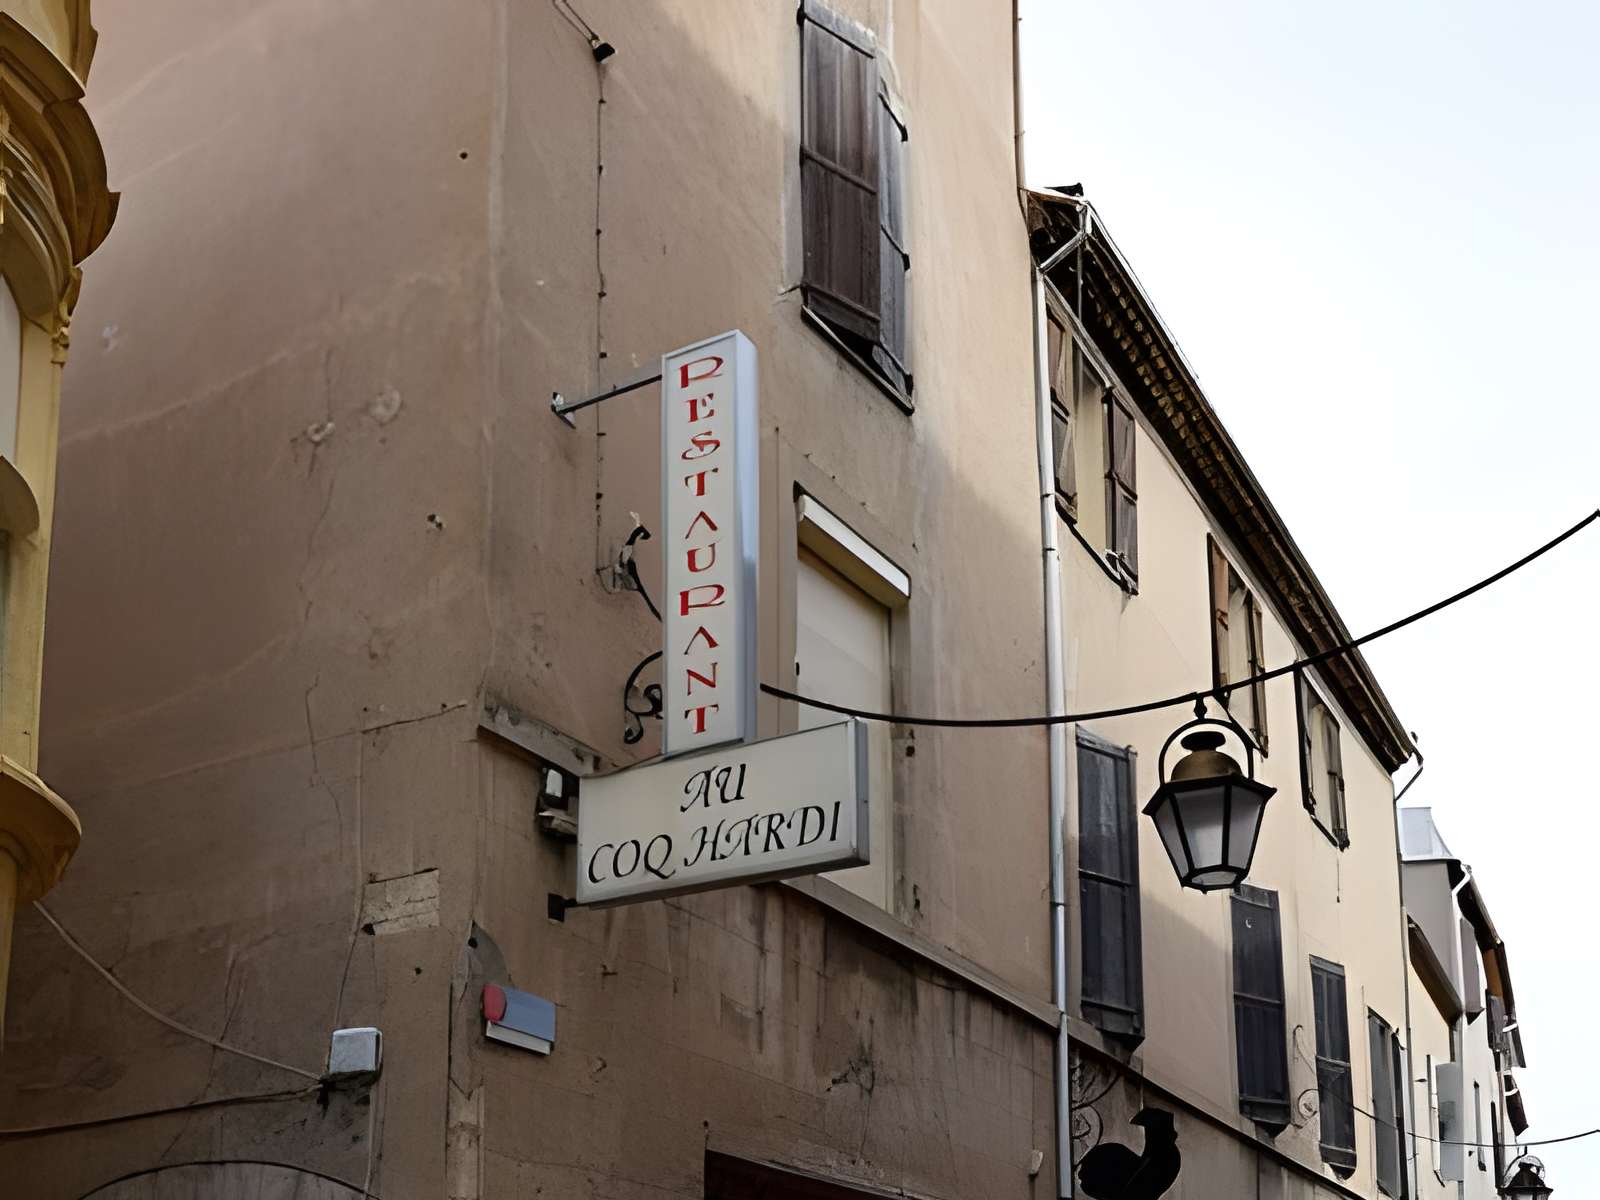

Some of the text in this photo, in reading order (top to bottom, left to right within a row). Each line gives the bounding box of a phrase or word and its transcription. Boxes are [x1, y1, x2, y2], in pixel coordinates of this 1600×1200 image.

[678, 355, 726, 736] RESTAURANT
[680, 763, 747, 813] AU
[588, 801, 841, 884] COQ HARDI
